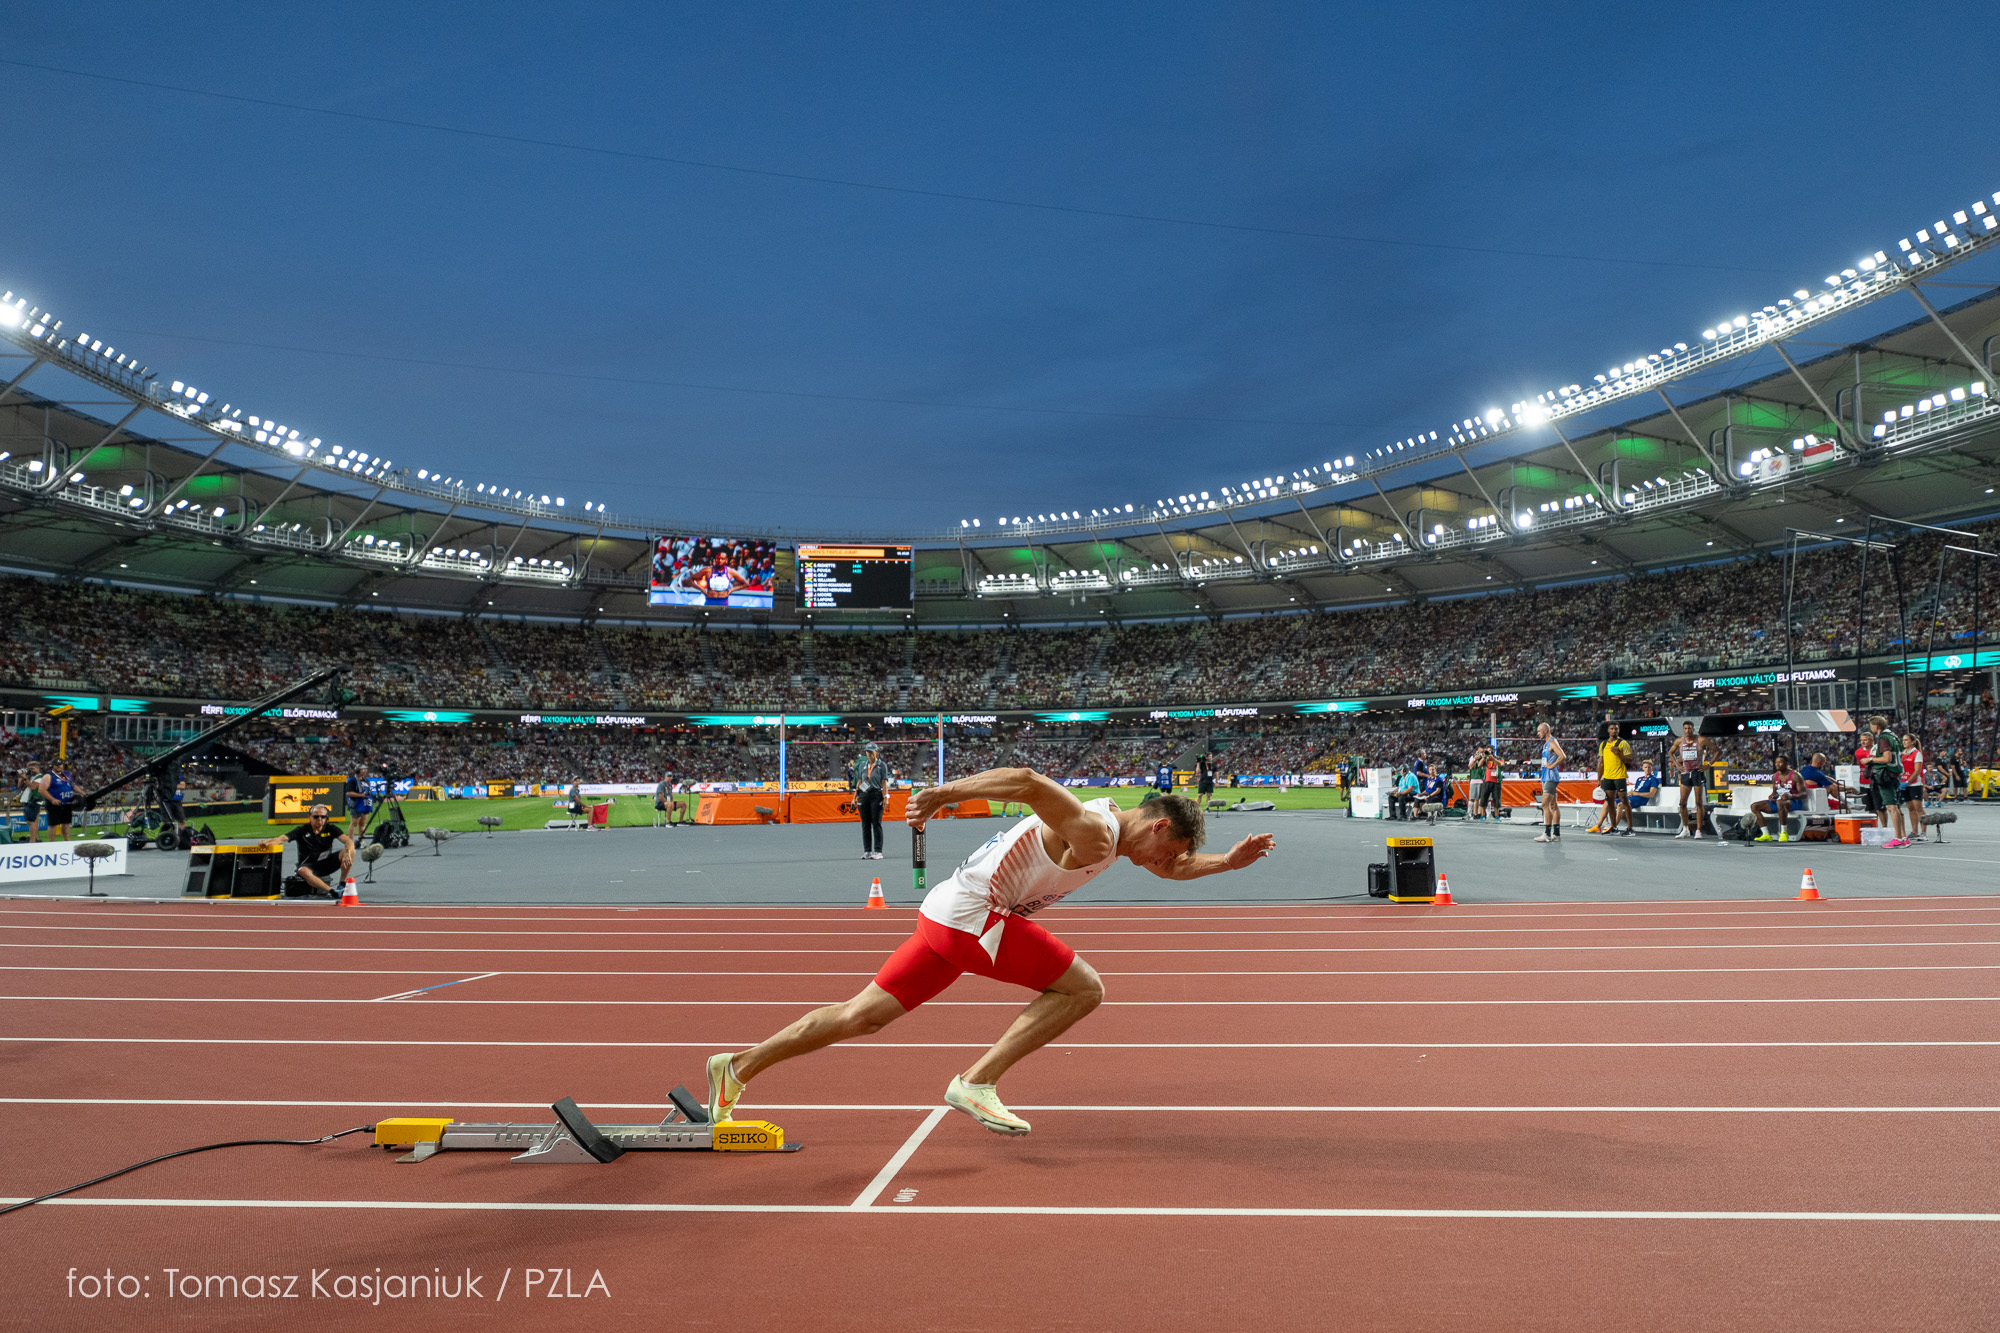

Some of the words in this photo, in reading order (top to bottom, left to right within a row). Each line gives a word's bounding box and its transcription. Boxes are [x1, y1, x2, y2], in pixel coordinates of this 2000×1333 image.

[1693, 678, 1715, 689] FÉRFI
[1715, 676, 1748, 687] 4X100M
[1749, 672, 1776, 684] VÁLTÓ
[1408, 698, 1426, 708] FÉRFI
[1426, 697, 1452, 707] 4X100M
[1453, 694, 1473, 705] VÁLTÓ
[1473, 693, 1519, 704] ELŐFUTAMOK
[201, 704, 224, 715] FÉRFI
[224, 706, 253, 716] 4X100
[283, 707, 337, 719] ELŐFUTAMOK
[1150, 710, 1168, 719] FÉRFI
[1168, 709, 1194, 718] 4X100M
[1194, 708, 1215, 718] VÁLTÓ
[1215, 707, 1258, 717] ELŐFUTAMOK
[520, 714, 541, 723] FÉRFI
[541, 715, 571, 724] 4X100M
[571, 714, 596, 724] VÁLTÓ
[596, 714, 645, 724] ELŐFUTAMOK
[883, 715, 903, 724] FÉRFI
[903, 716, 930, 724] 4X100M
[930, 714, 952, 724] VÁTÓ
[952, 714, 997, 723] ELŐFUTAMOK
[918, 876, 924, 885] 8
[718, 1132, 768, 1144] SEIKO
